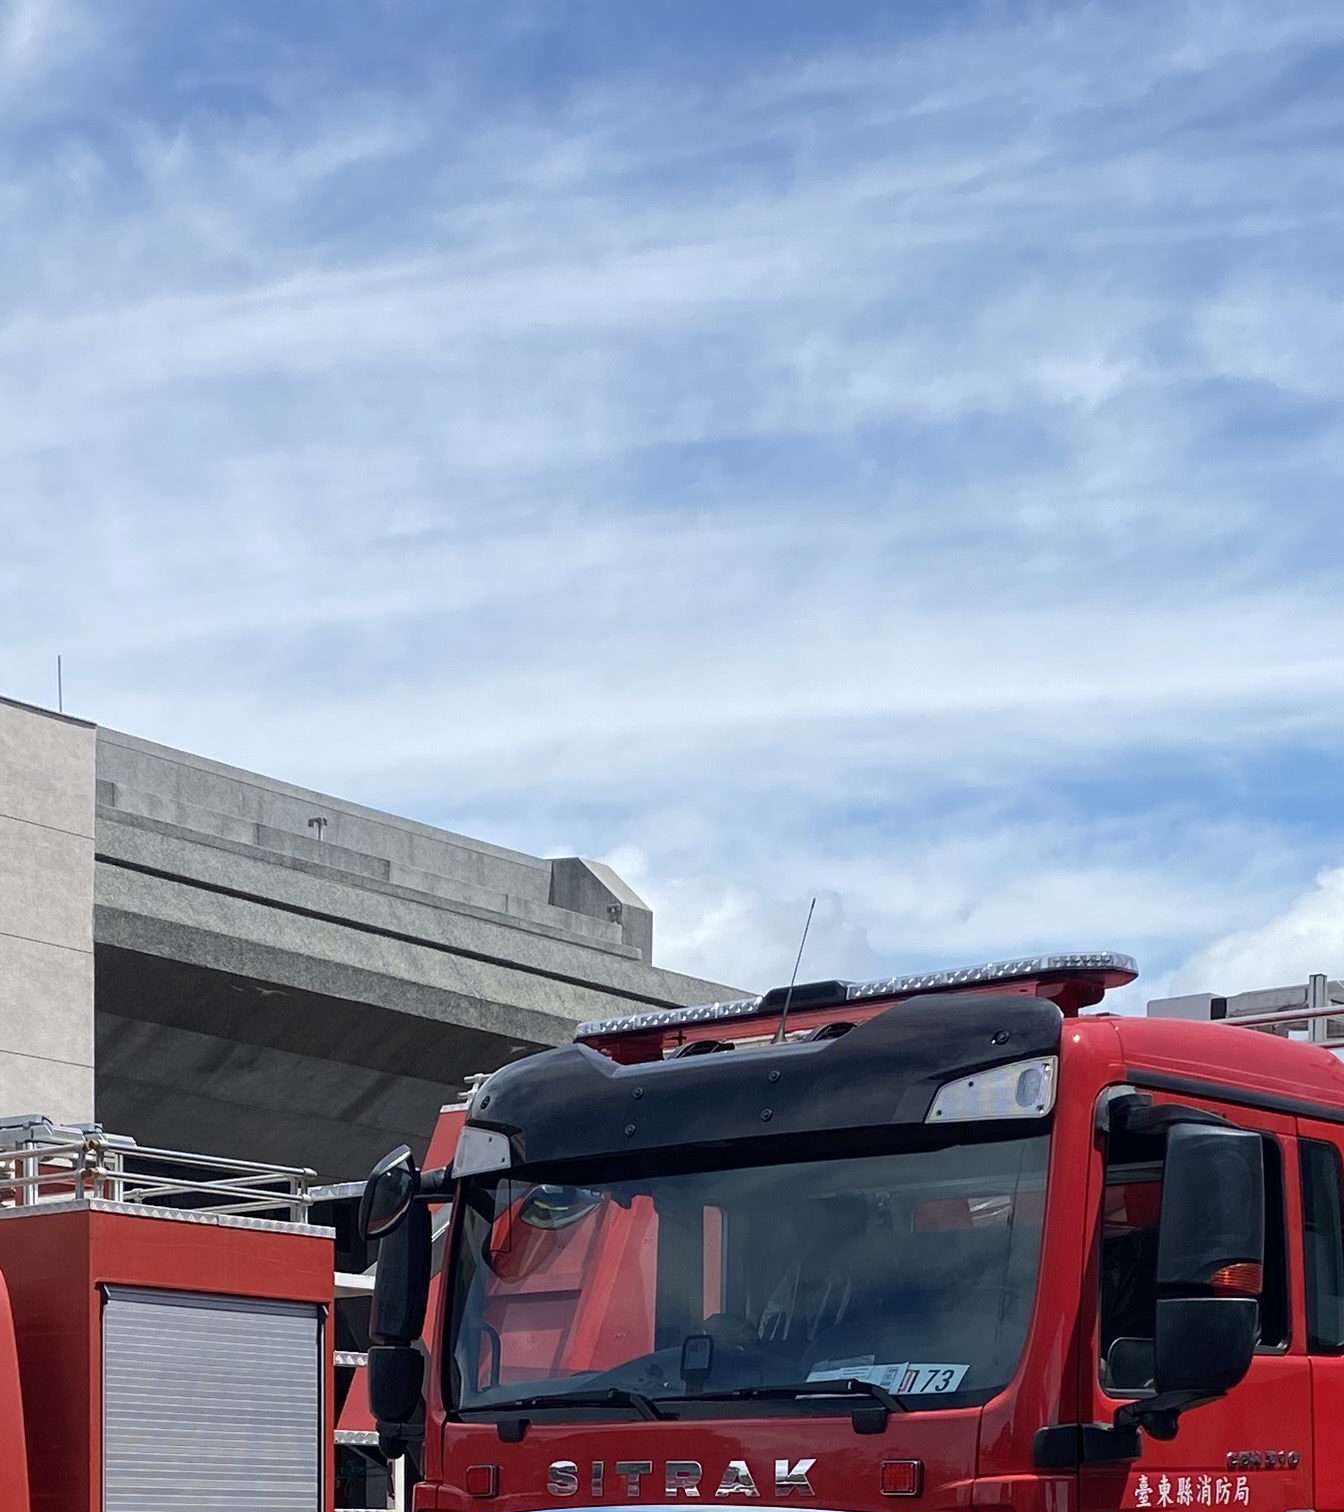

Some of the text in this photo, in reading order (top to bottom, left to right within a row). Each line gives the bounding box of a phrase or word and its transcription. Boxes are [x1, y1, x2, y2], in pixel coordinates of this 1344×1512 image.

[547, 1459, 817, 1497] SITRAK
[1134, 1474, 1250, 1508] 臺東縣消防局
